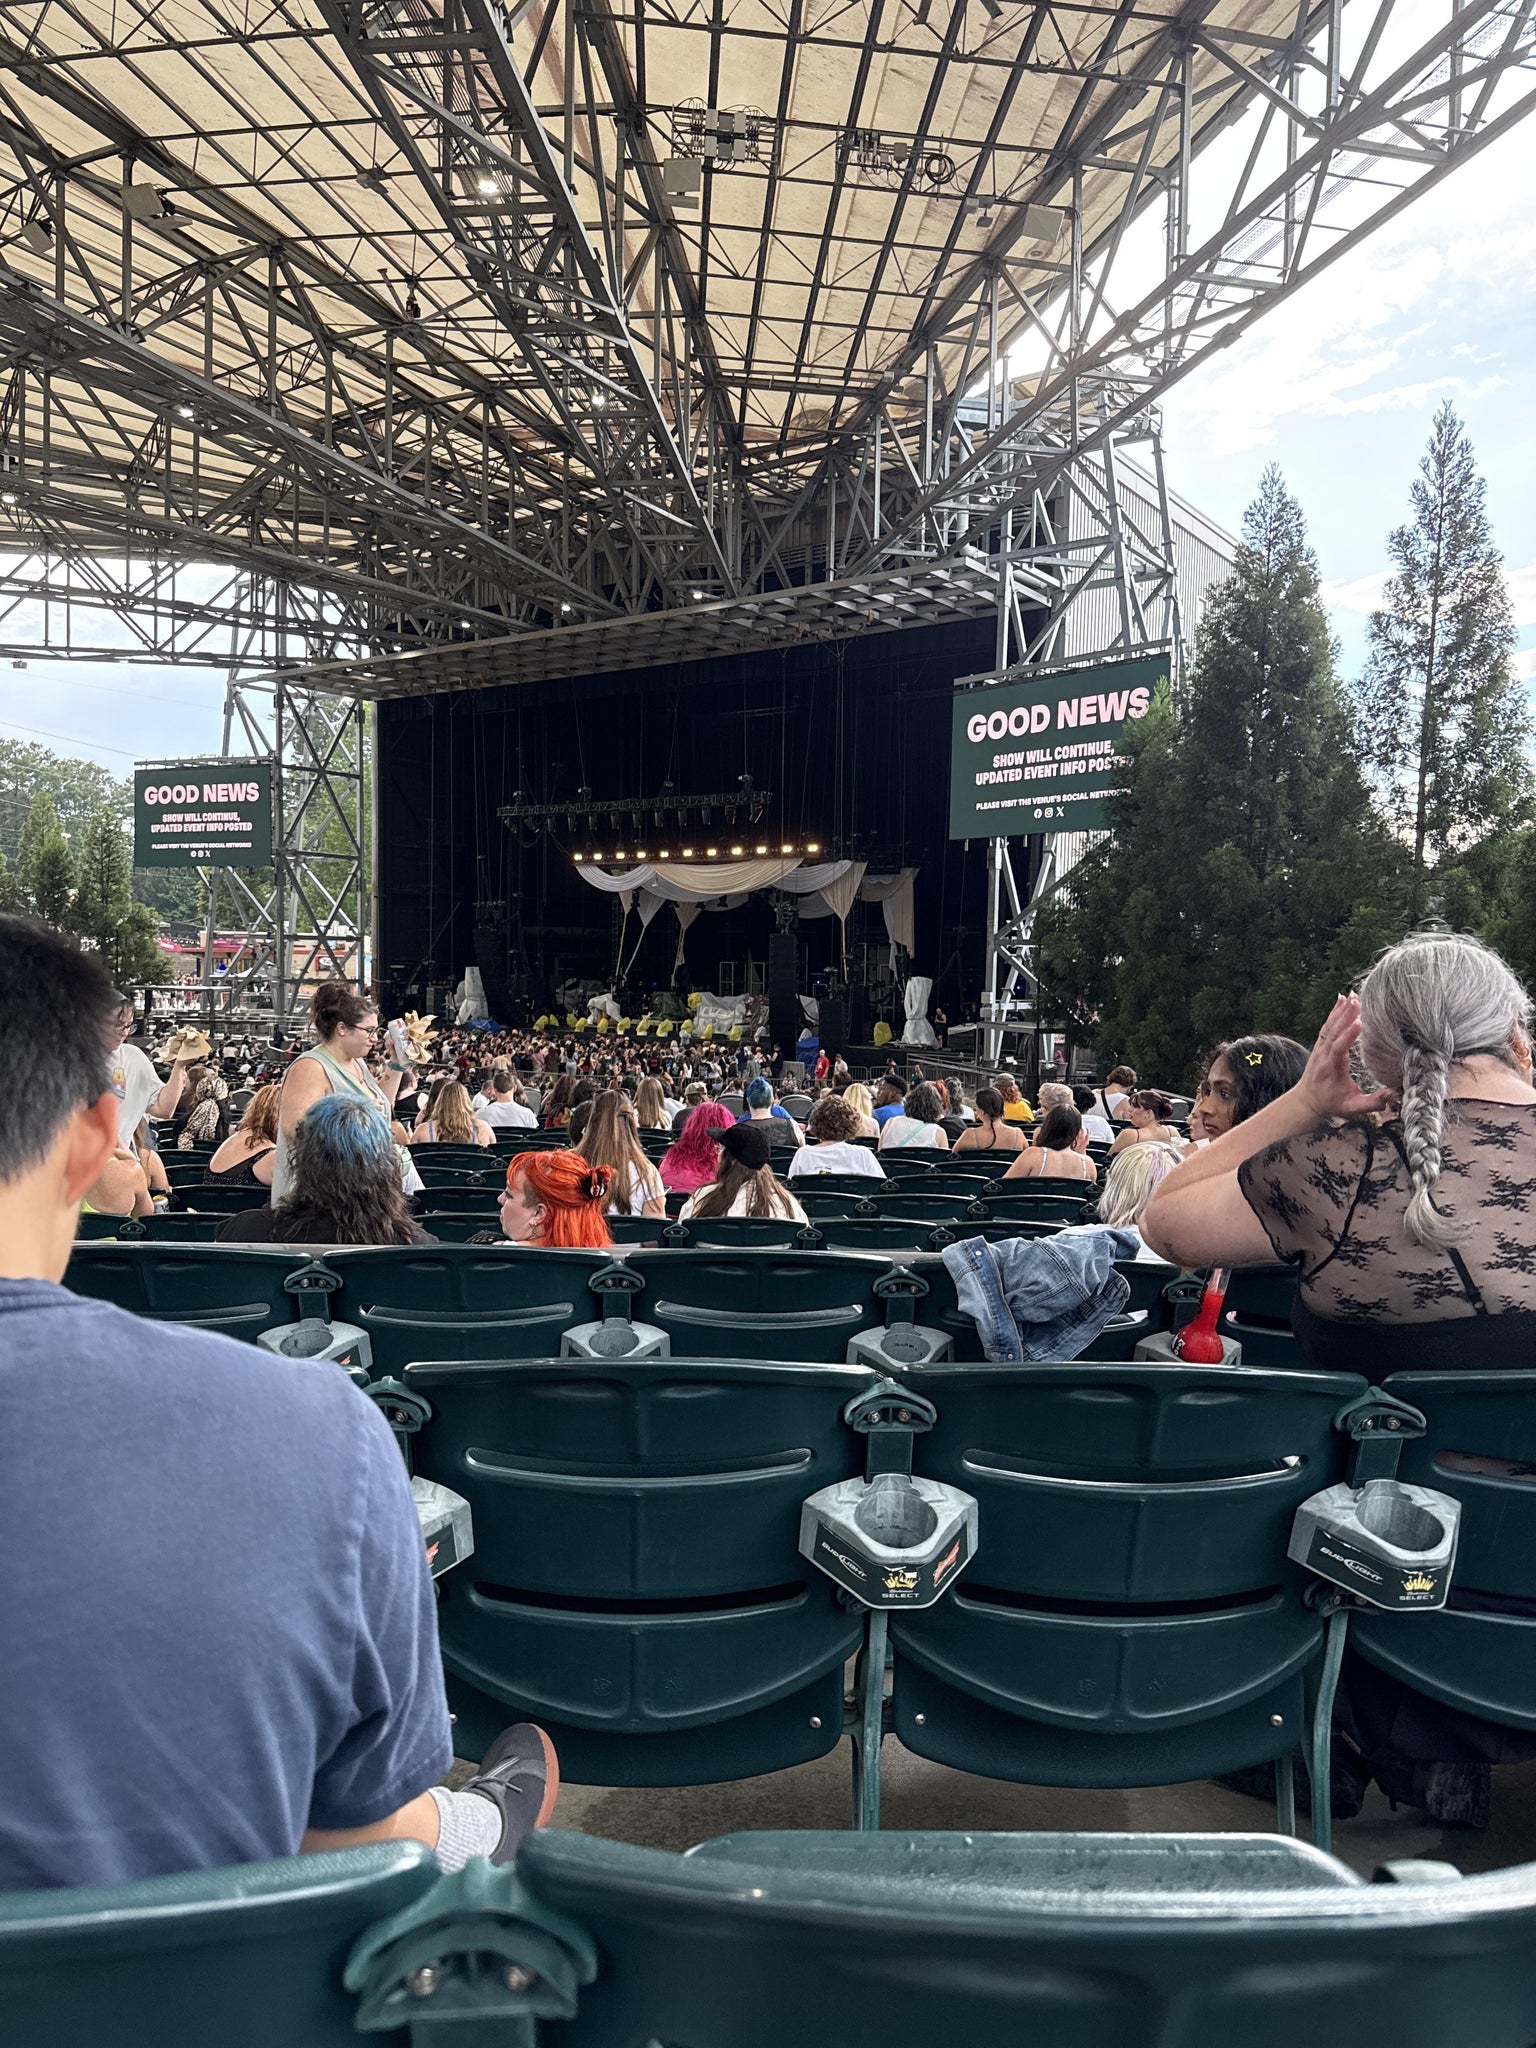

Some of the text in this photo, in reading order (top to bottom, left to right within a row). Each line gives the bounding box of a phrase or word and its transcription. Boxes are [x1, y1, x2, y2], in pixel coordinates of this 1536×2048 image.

[967, 687, 1150, 742] GOOD NEWS
[993, 740, 1115, 769] SHOW WILL CONTINUE,
[975, 768, 1022, 786] UPDATED
[1024, 762, 1058, 780] EVENT
[1060, 760, 1086, 776] INFO
[144, 782, 259, 805] GOOD NEWS
[975, 802, 1000, 811] PLEASE
[1000, 799, 1018, 808] VISIT
[1018, 798, 1032, 806] THE
[1032, 794, 1061, 805] VENUE'S
[1062, 792, 1089, 802] SOCIAL
[151, 822, 253, 833] UPDATED EVENT INFO POSTED
[162, 812, 241, 823] SHOW WILL CONTINUE,
[821, 1541, 868, 1577] BUD LIGHT
[1320, 1547, 1384, 1581] BUD LIGHT
